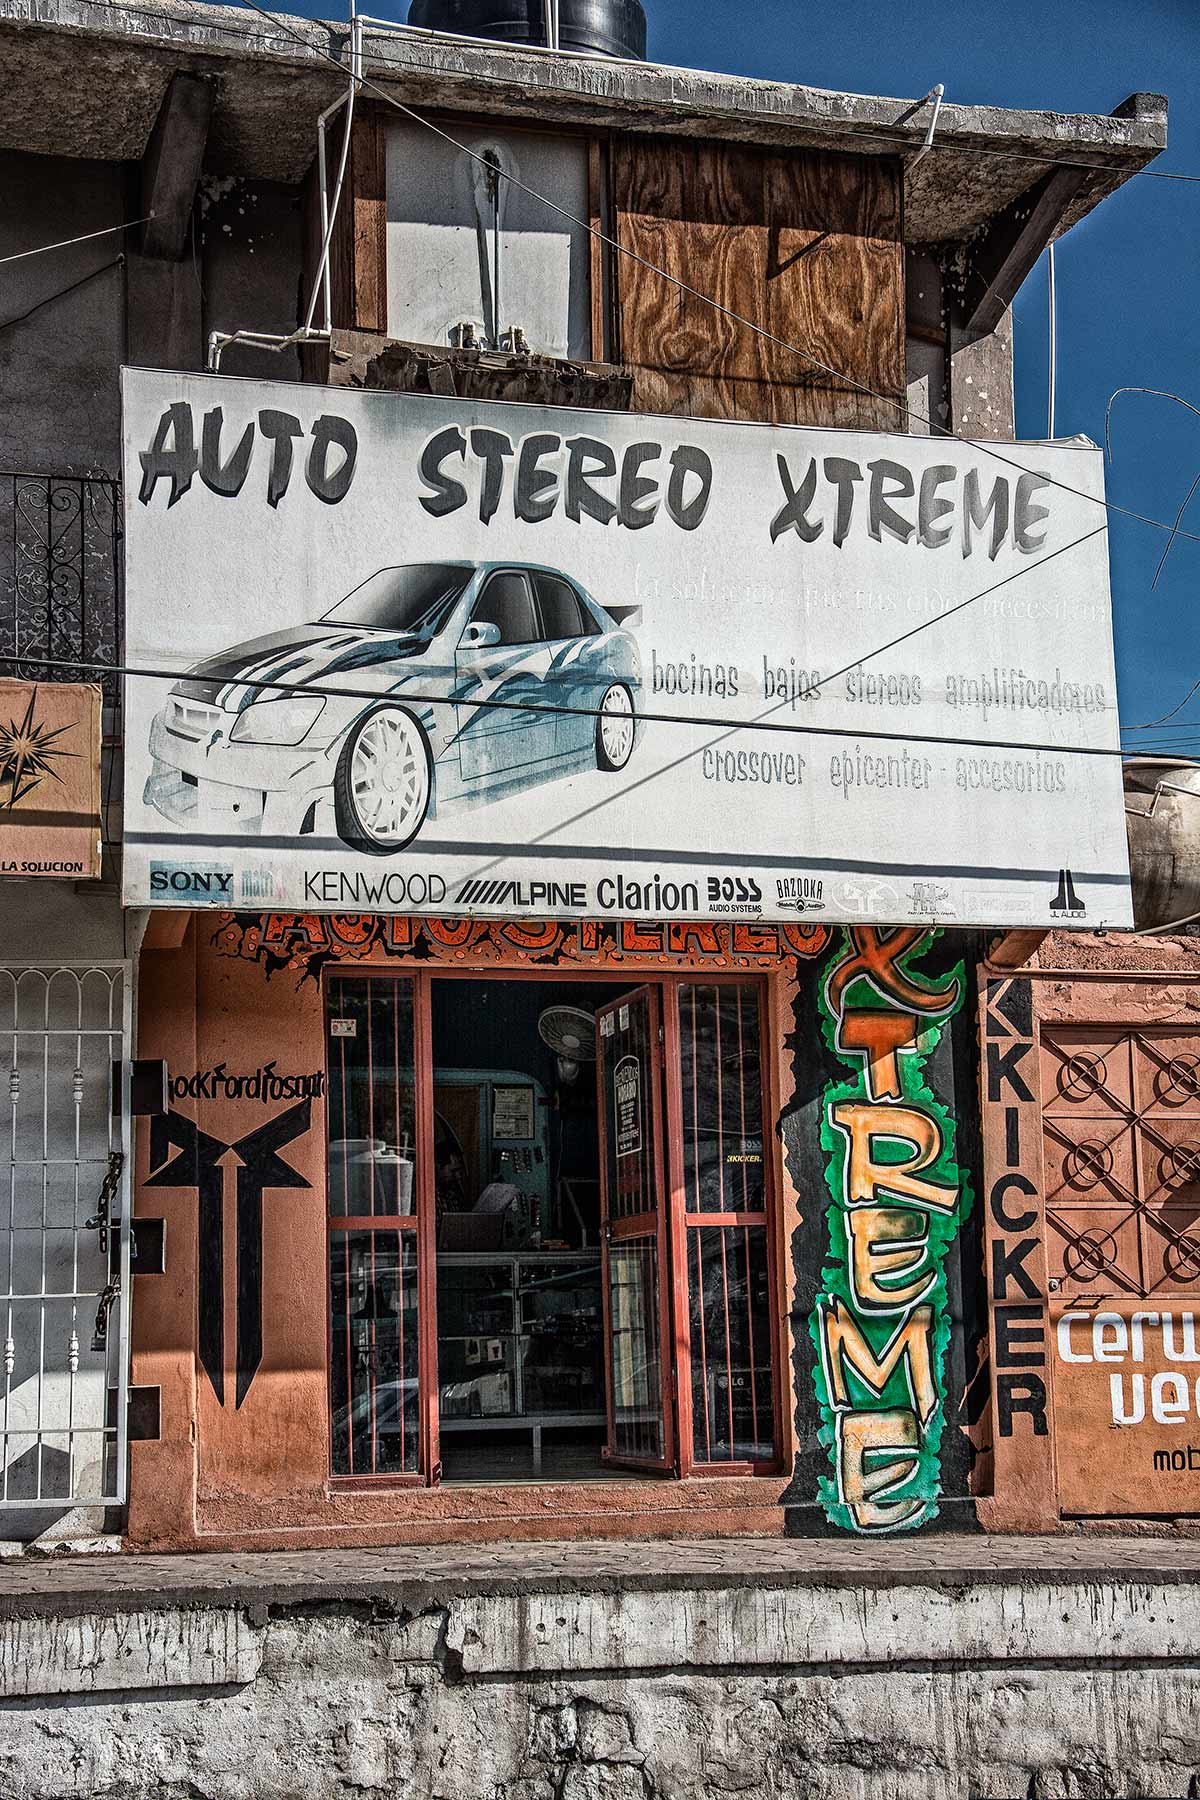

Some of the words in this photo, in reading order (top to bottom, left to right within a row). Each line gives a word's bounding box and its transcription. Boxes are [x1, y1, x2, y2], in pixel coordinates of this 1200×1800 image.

[138, 401, 358, 510] AUTO
[416, 423, 713, 531] STEREO
[770, 450, 1052, 561] XTREME
[651, 648, 739, 698] bocinas
[763, 654, 822, 711] bajos
[845, 663, 921, 706] stereos
[702, 749, 806, 786] crossover
[829, 745, 932, 801] epicenter
[955, 750, 1067, 793] accesorios
[2, 861, 18, 872] LA
[21, 861, 84, 873] SOLUCION
[150, 871, 234, 893] SONY
[304, 870, 447, 905] KENWOOD
[494, 880, 588, 907] ALPINE
[597, 874, 699, 912] Clarion
[707, 876, 762, 902] BOSS
[776, 878, 823, 900] BAZOOKA
[708, 904, 730, 913] AUDIO
[731, 904, 762, 913] SYSTEMS
[1109, 1371, 1200, 1425] ve
